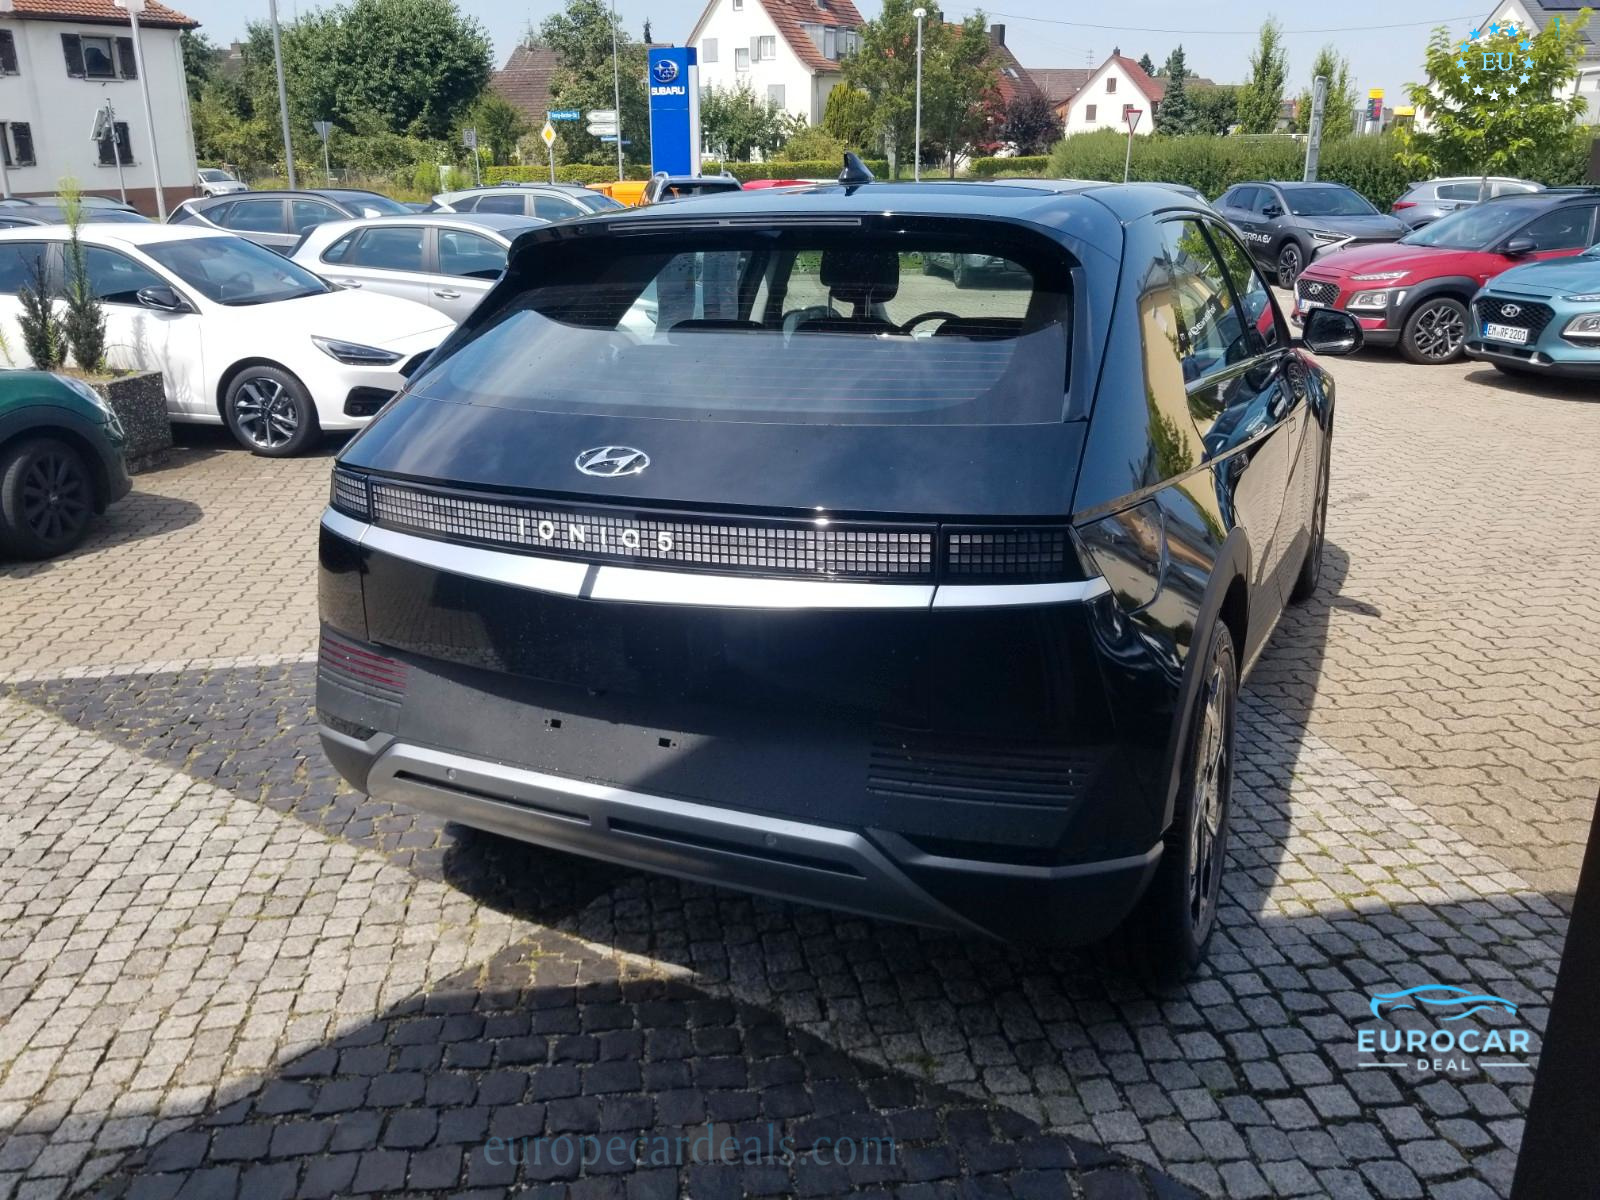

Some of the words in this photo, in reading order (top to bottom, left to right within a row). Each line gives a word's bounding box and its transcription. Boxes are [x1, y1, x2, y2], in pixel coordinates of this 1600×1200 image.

[651, 86, 686, 96] SUBARU
[518, 517, 640, 549] IONIQ
[657, 531, 674, 552] 5
